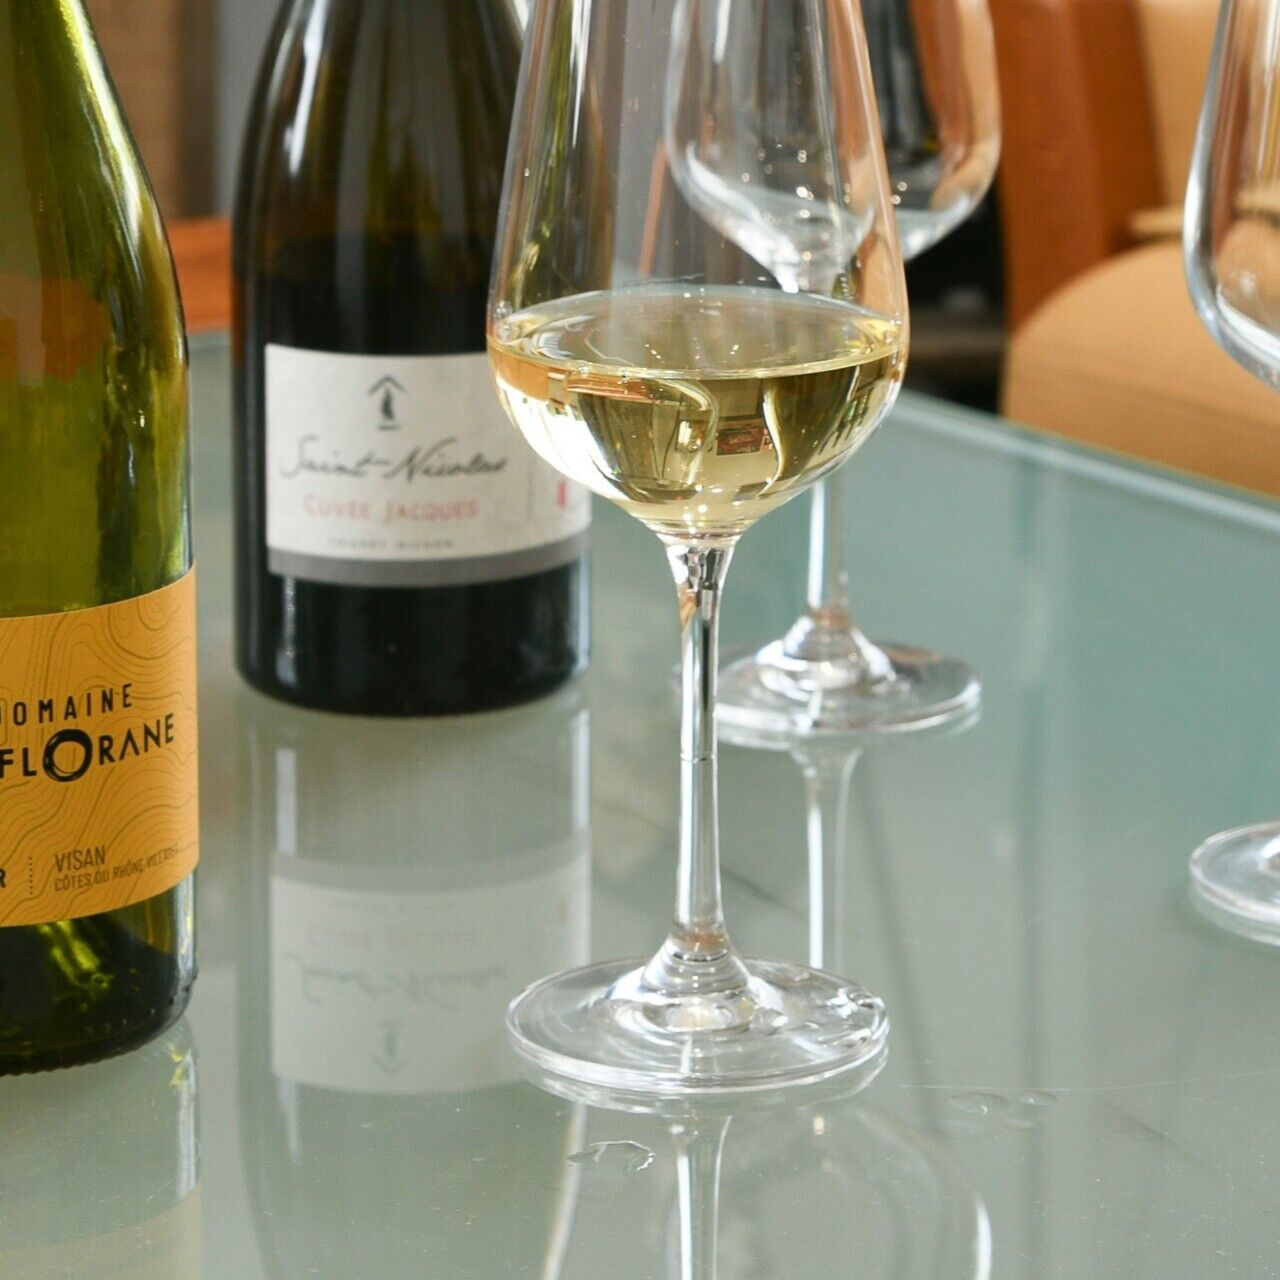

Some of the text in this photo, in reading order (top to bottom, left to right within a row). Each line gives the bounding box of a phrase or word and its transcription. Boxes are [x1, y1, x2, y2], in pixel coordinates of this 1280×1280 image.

[54, 844, 106, 873] VISAN
[54, 872, 93, 892] CÔTES
[95, 868, 110, 885] DU
[112, 857, 144, 880] RHÔNE
